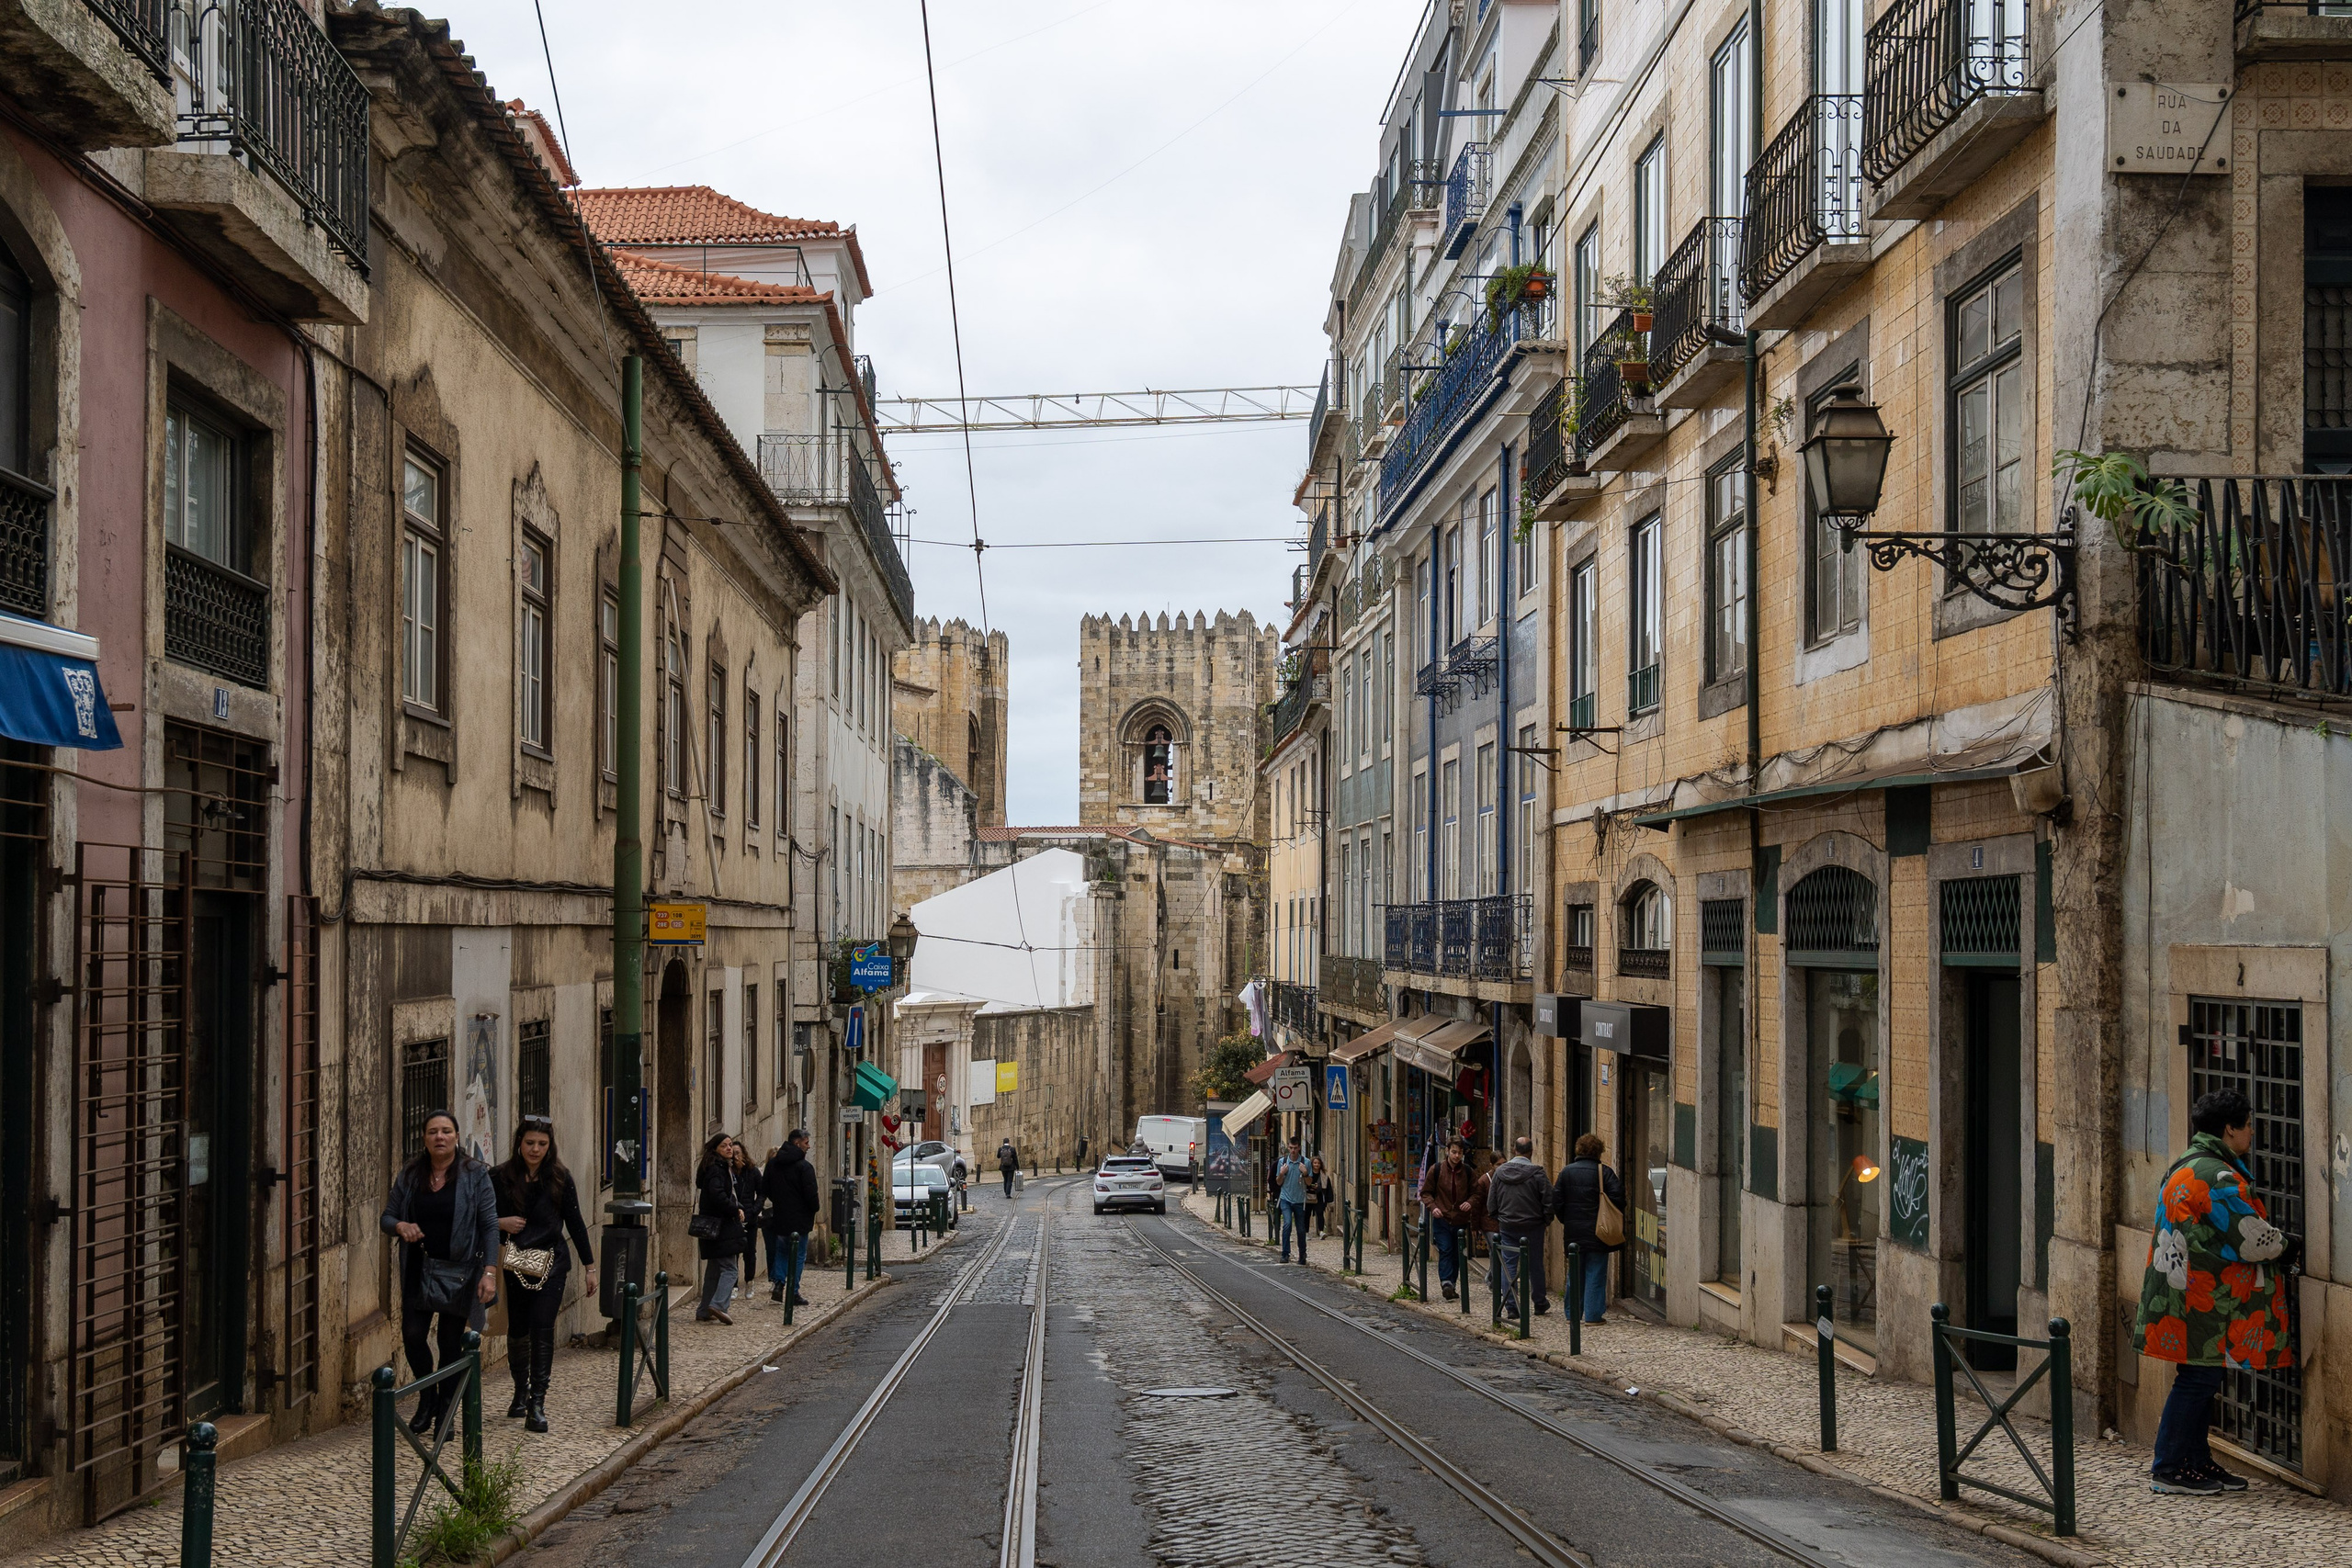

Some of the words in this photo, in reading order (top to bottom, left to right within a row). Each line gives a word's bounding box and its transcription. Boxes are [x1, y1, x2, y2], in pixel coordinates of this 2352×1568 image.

[2157, 95, 2187, 109] RUA
[2162, 120, 2182, 134] DA
[2136, 145, 2206, 161] SAUDADE
[217, 689, 229, 717] 13
[1973, 848, 1980, 867] 4
[854, 967, 889, 976] Alfama
[867, 962, 889, 970] Caixa
[1595, 1021, 1613, 1039] CONTRAST
[940, 1079, 946, 1089] 30
